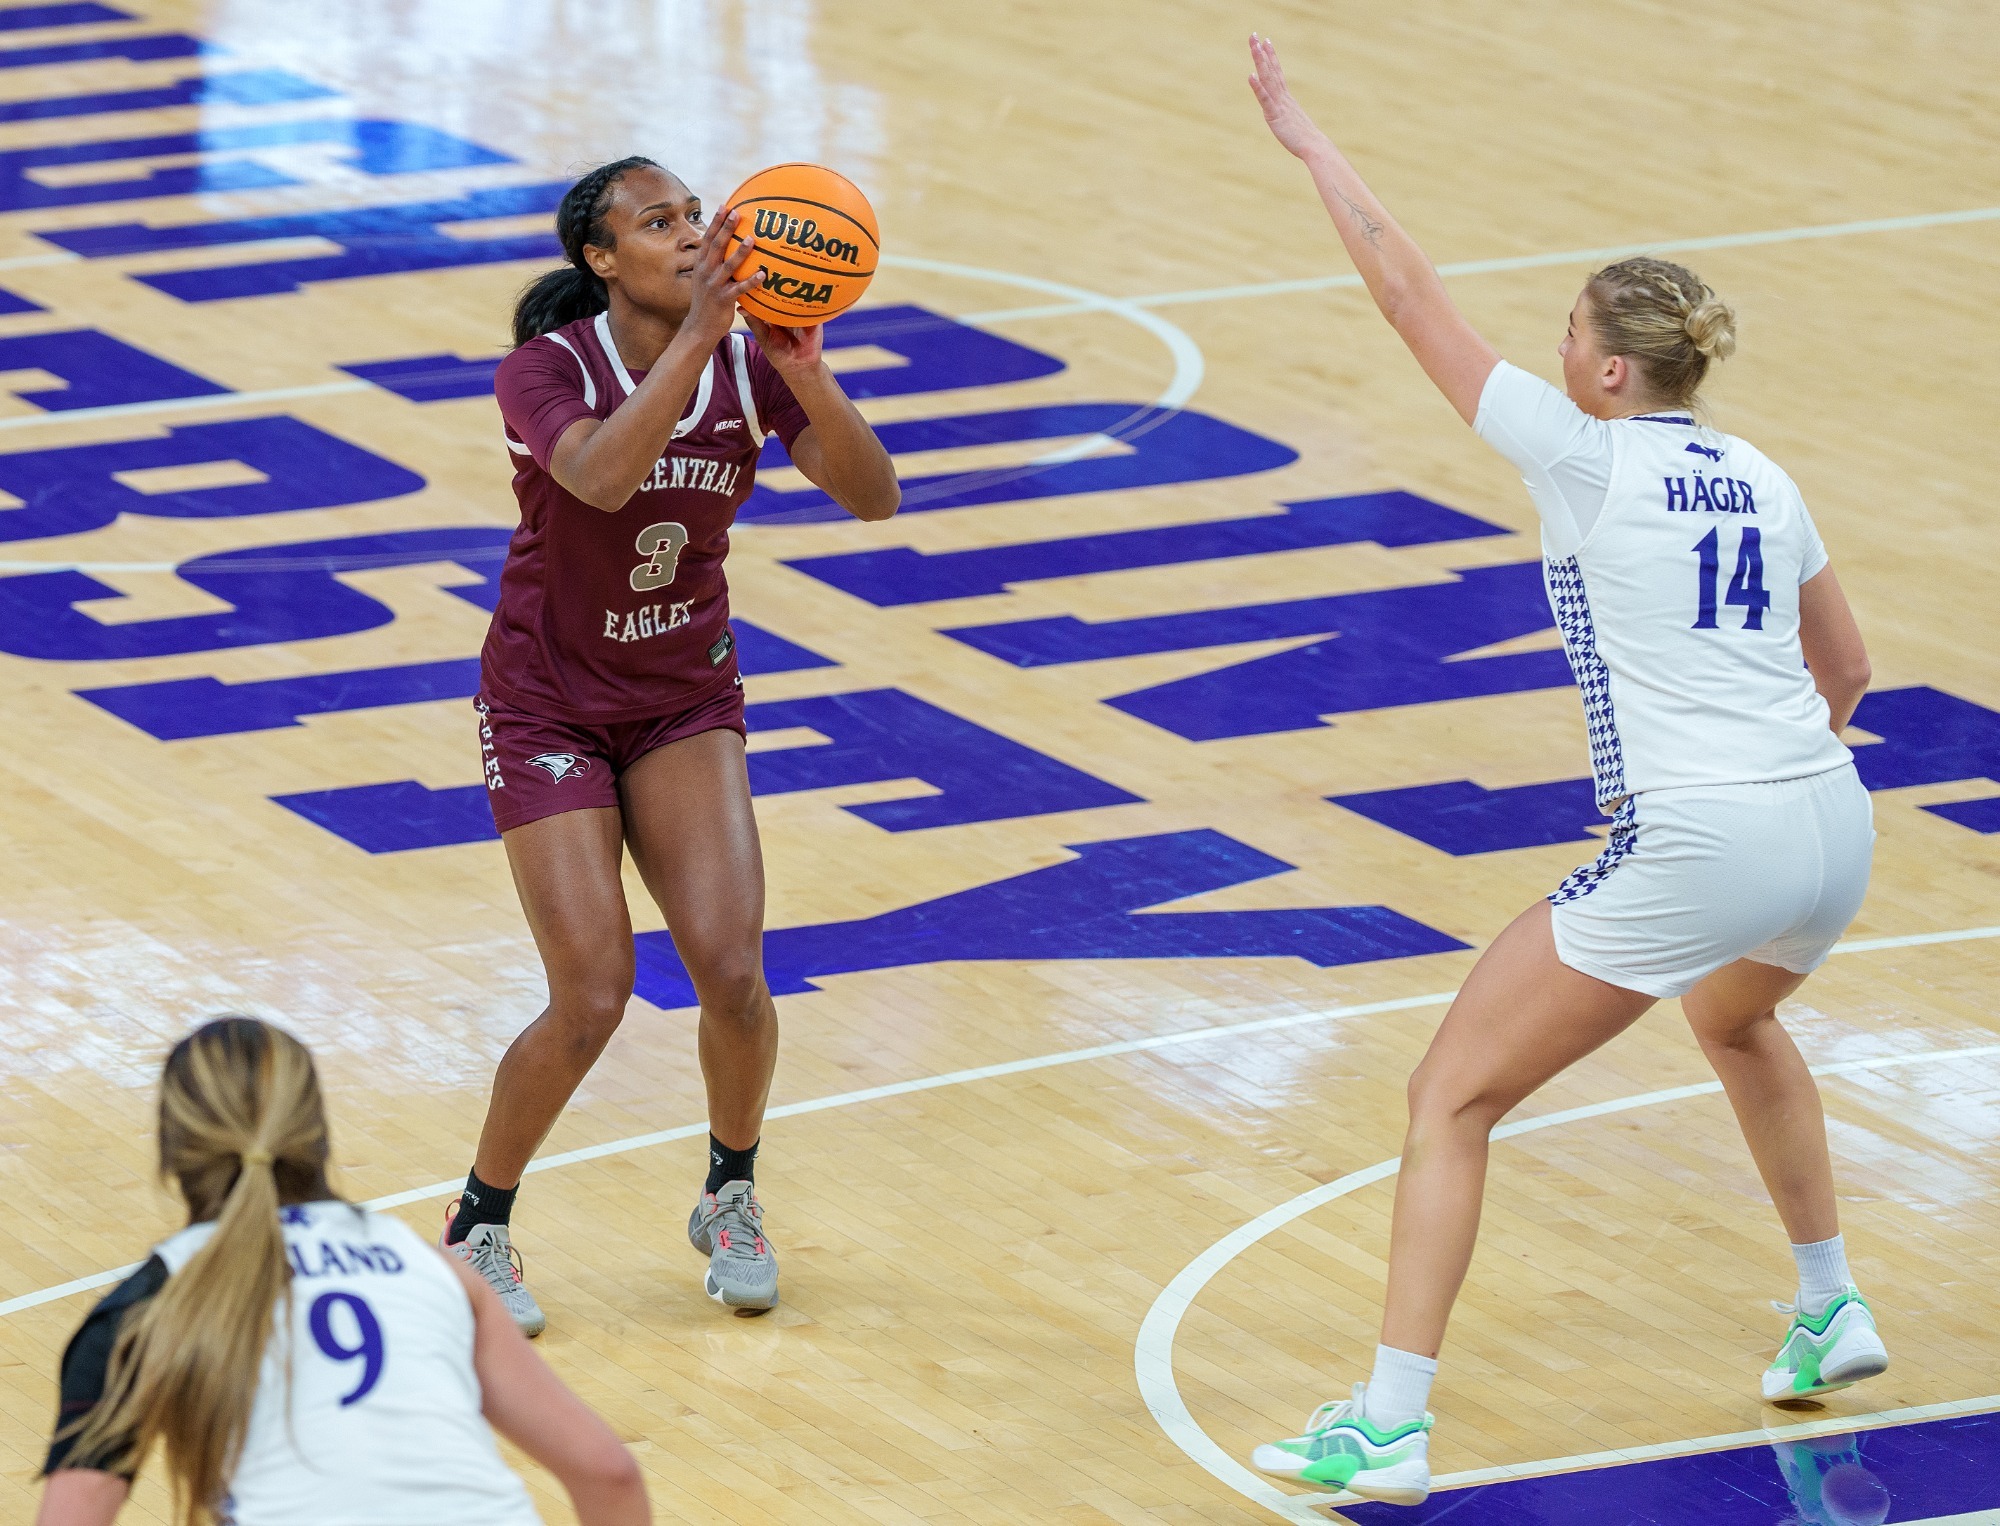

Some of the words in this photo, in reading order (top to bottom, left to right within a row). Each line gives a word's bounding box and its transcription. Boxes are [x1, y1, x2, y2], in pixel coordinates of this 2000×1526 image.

[753, 207, 861, 267] Wilson
[758, 263, 835, 305] NCAA
[713, 419, 742, 433] MEAC
[1663, 468, 1759, 515] HÄGER
[630, 521, 690, 592] 3
[1690, 525, 1771, 631] 14
[602, 597, 696, 643] EAGLES
[288, 1240, 407, 1278] LAND
[308, 1290, 385, 1409] 9
